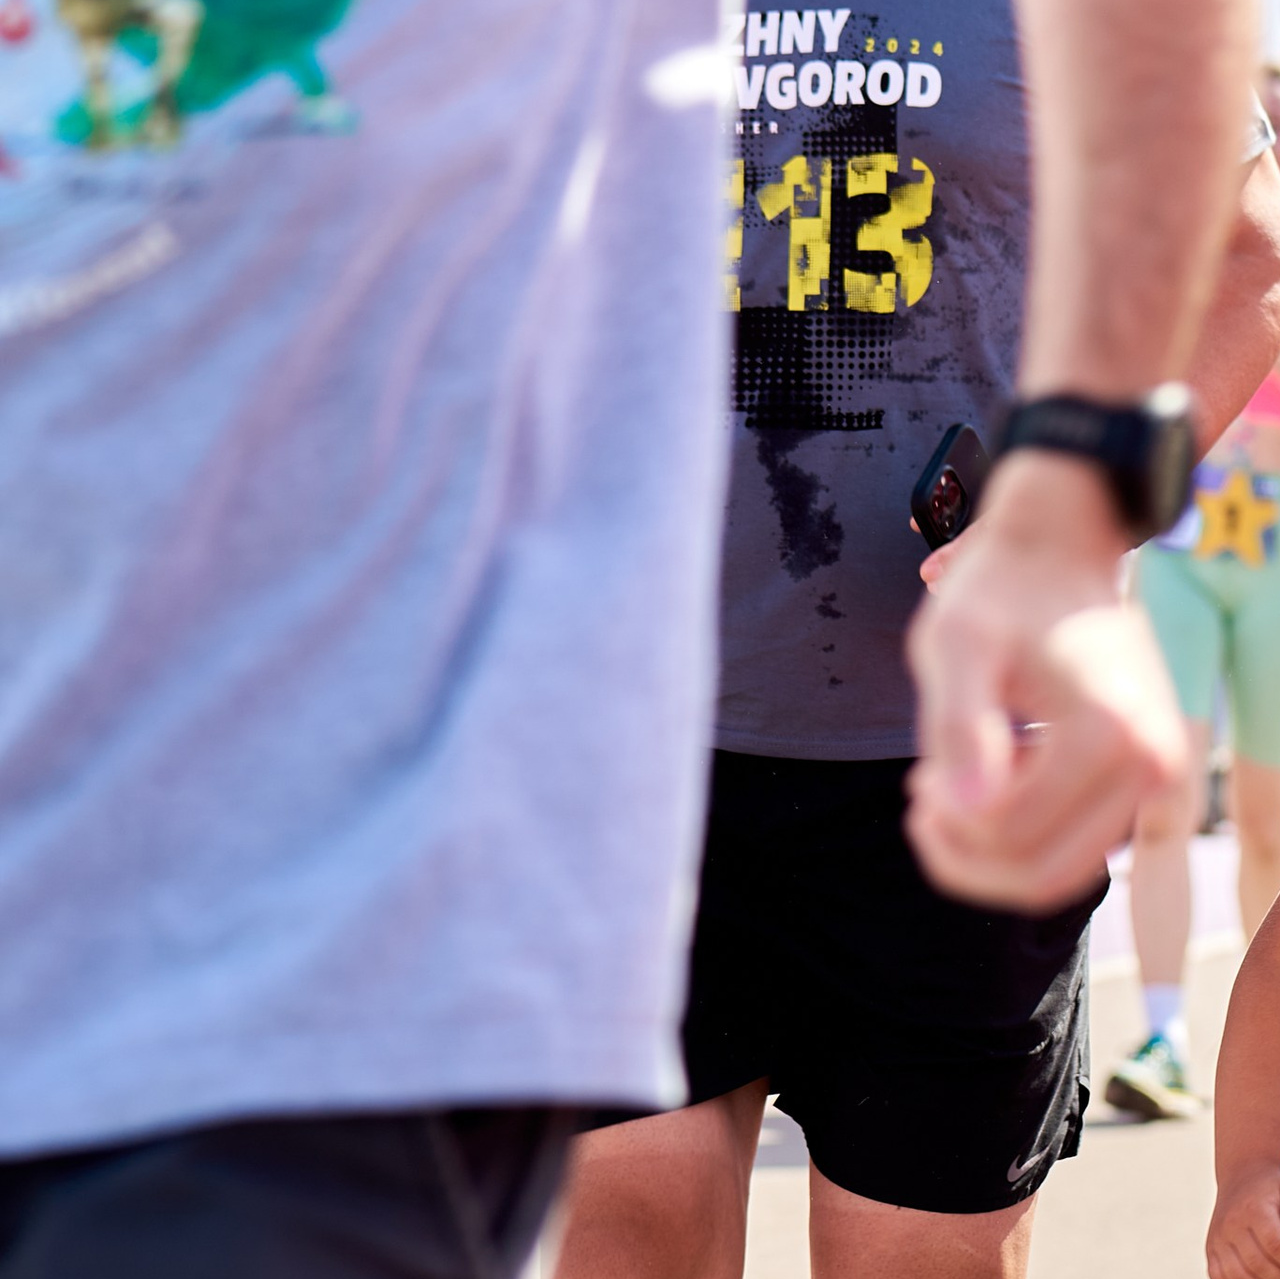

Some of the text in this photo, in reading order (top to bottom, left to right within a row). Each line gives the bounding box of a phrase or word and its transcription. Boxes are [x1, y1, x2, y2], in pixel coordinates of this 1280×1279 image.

[724, 8, 851, 58] ZHNY
[864, 37, 944, 57] 2024
[732, 59, 943, 111] VGOROD
